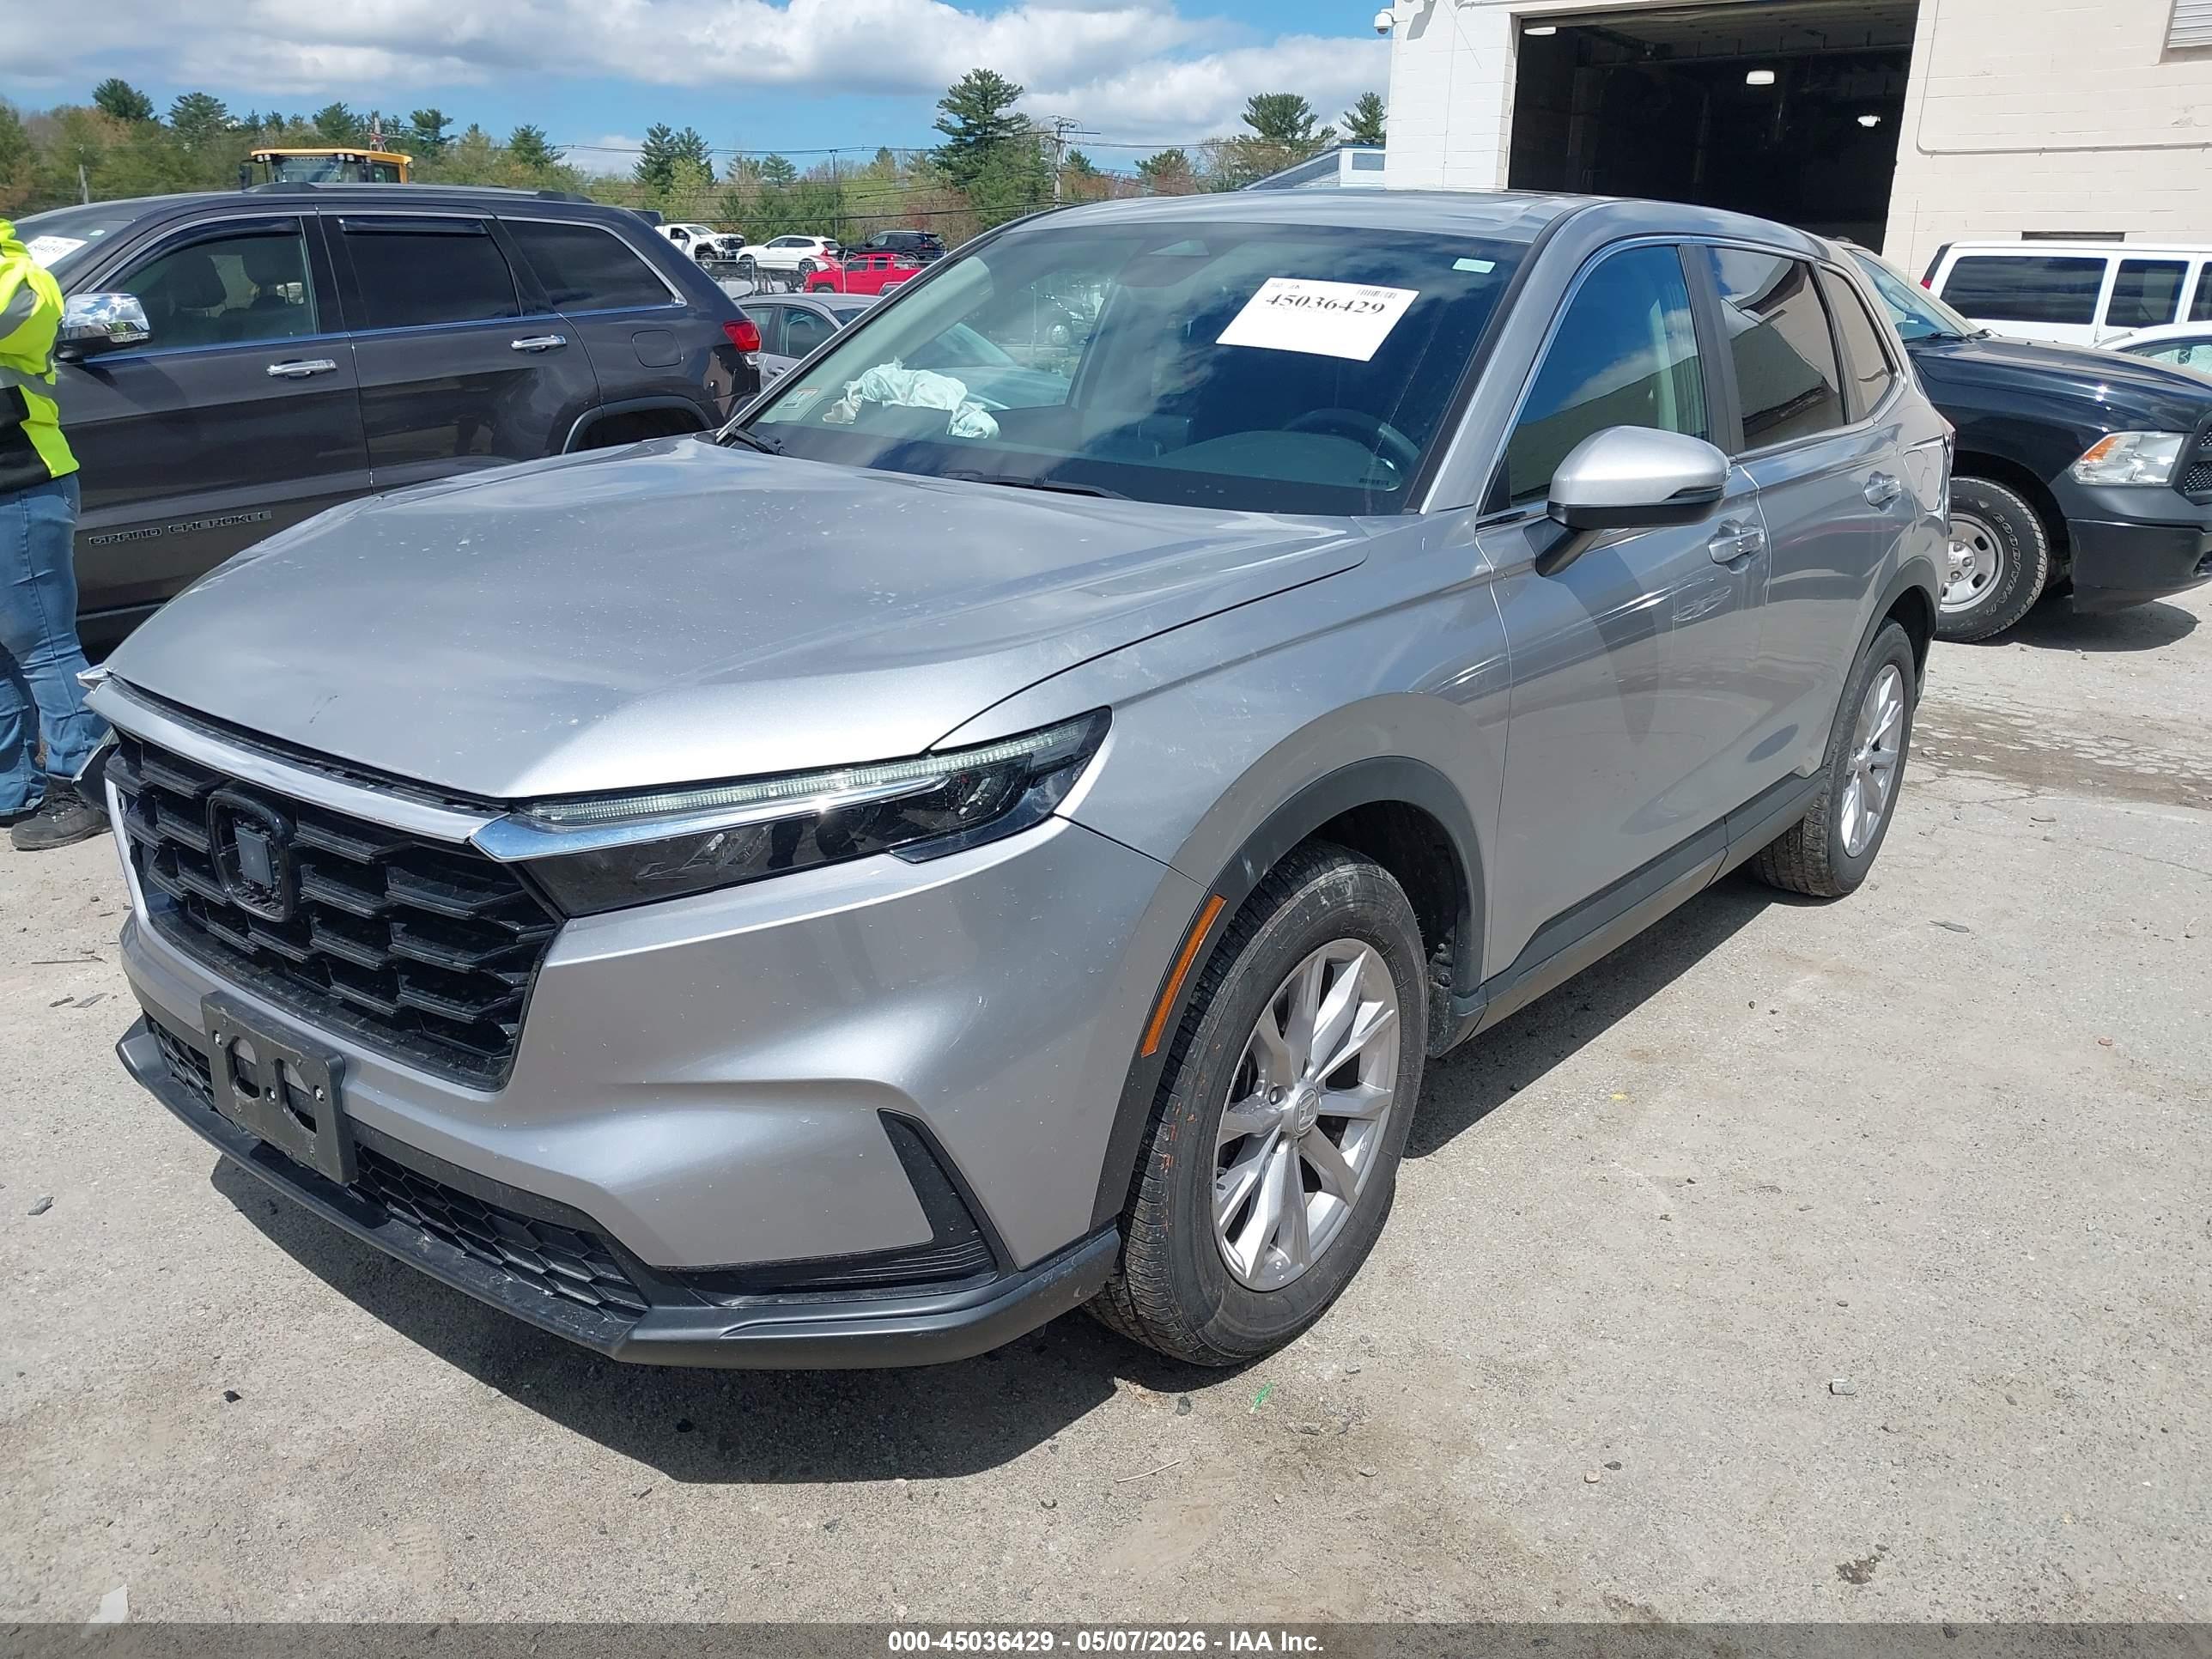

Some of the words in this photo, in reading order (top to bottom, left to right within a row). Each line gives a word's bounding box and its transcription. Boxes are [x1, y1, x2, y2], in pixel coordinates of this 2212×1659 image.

[1266, 294, 1385, 314] 45036429
[88, 528, 161, 546] GRAND
[168, 511, 272, 533] CHEROKEE
[1985, 514, 2021, 616] GOODYEAR
